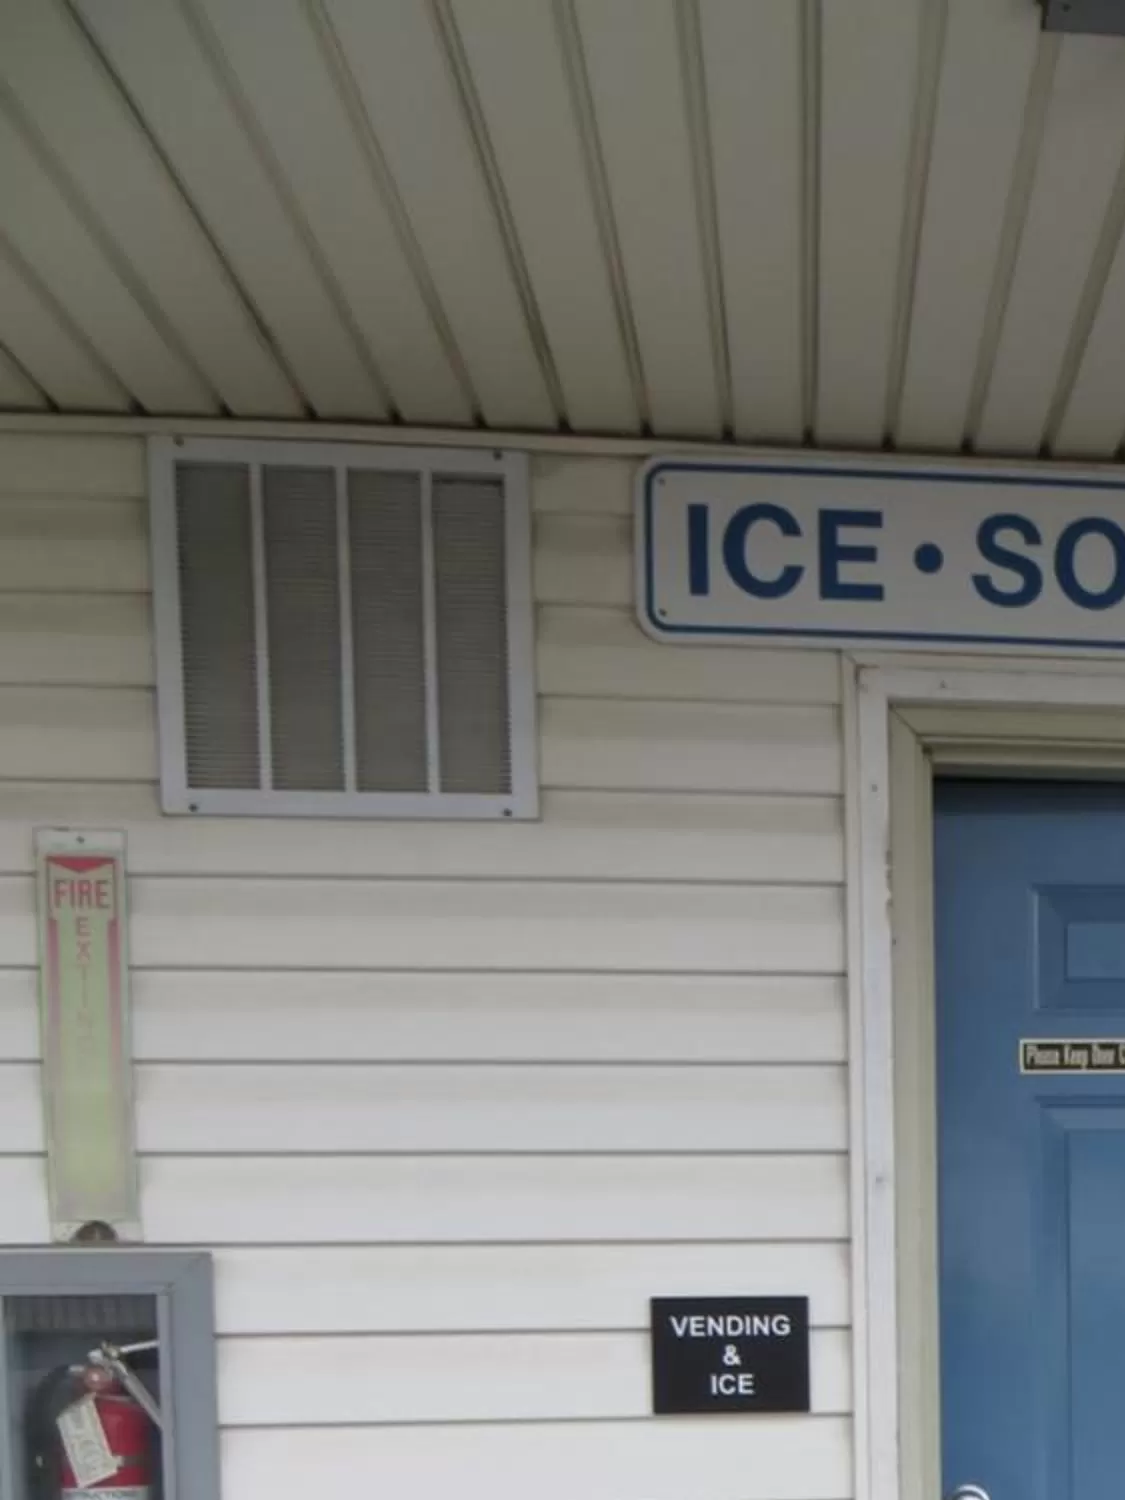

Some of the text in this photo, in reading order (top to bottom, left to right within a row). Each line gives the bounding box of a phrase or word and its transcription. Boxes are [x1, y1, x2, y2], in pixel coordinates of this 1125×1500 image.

[686, 503, 885, 601] ICE
[53, 879, 111, 909] FIRE
[670, 1314, 792, 1337] VENDING
[722, 1343, 742, 1366] &
[710, 1373, 755, 1395] ICE
